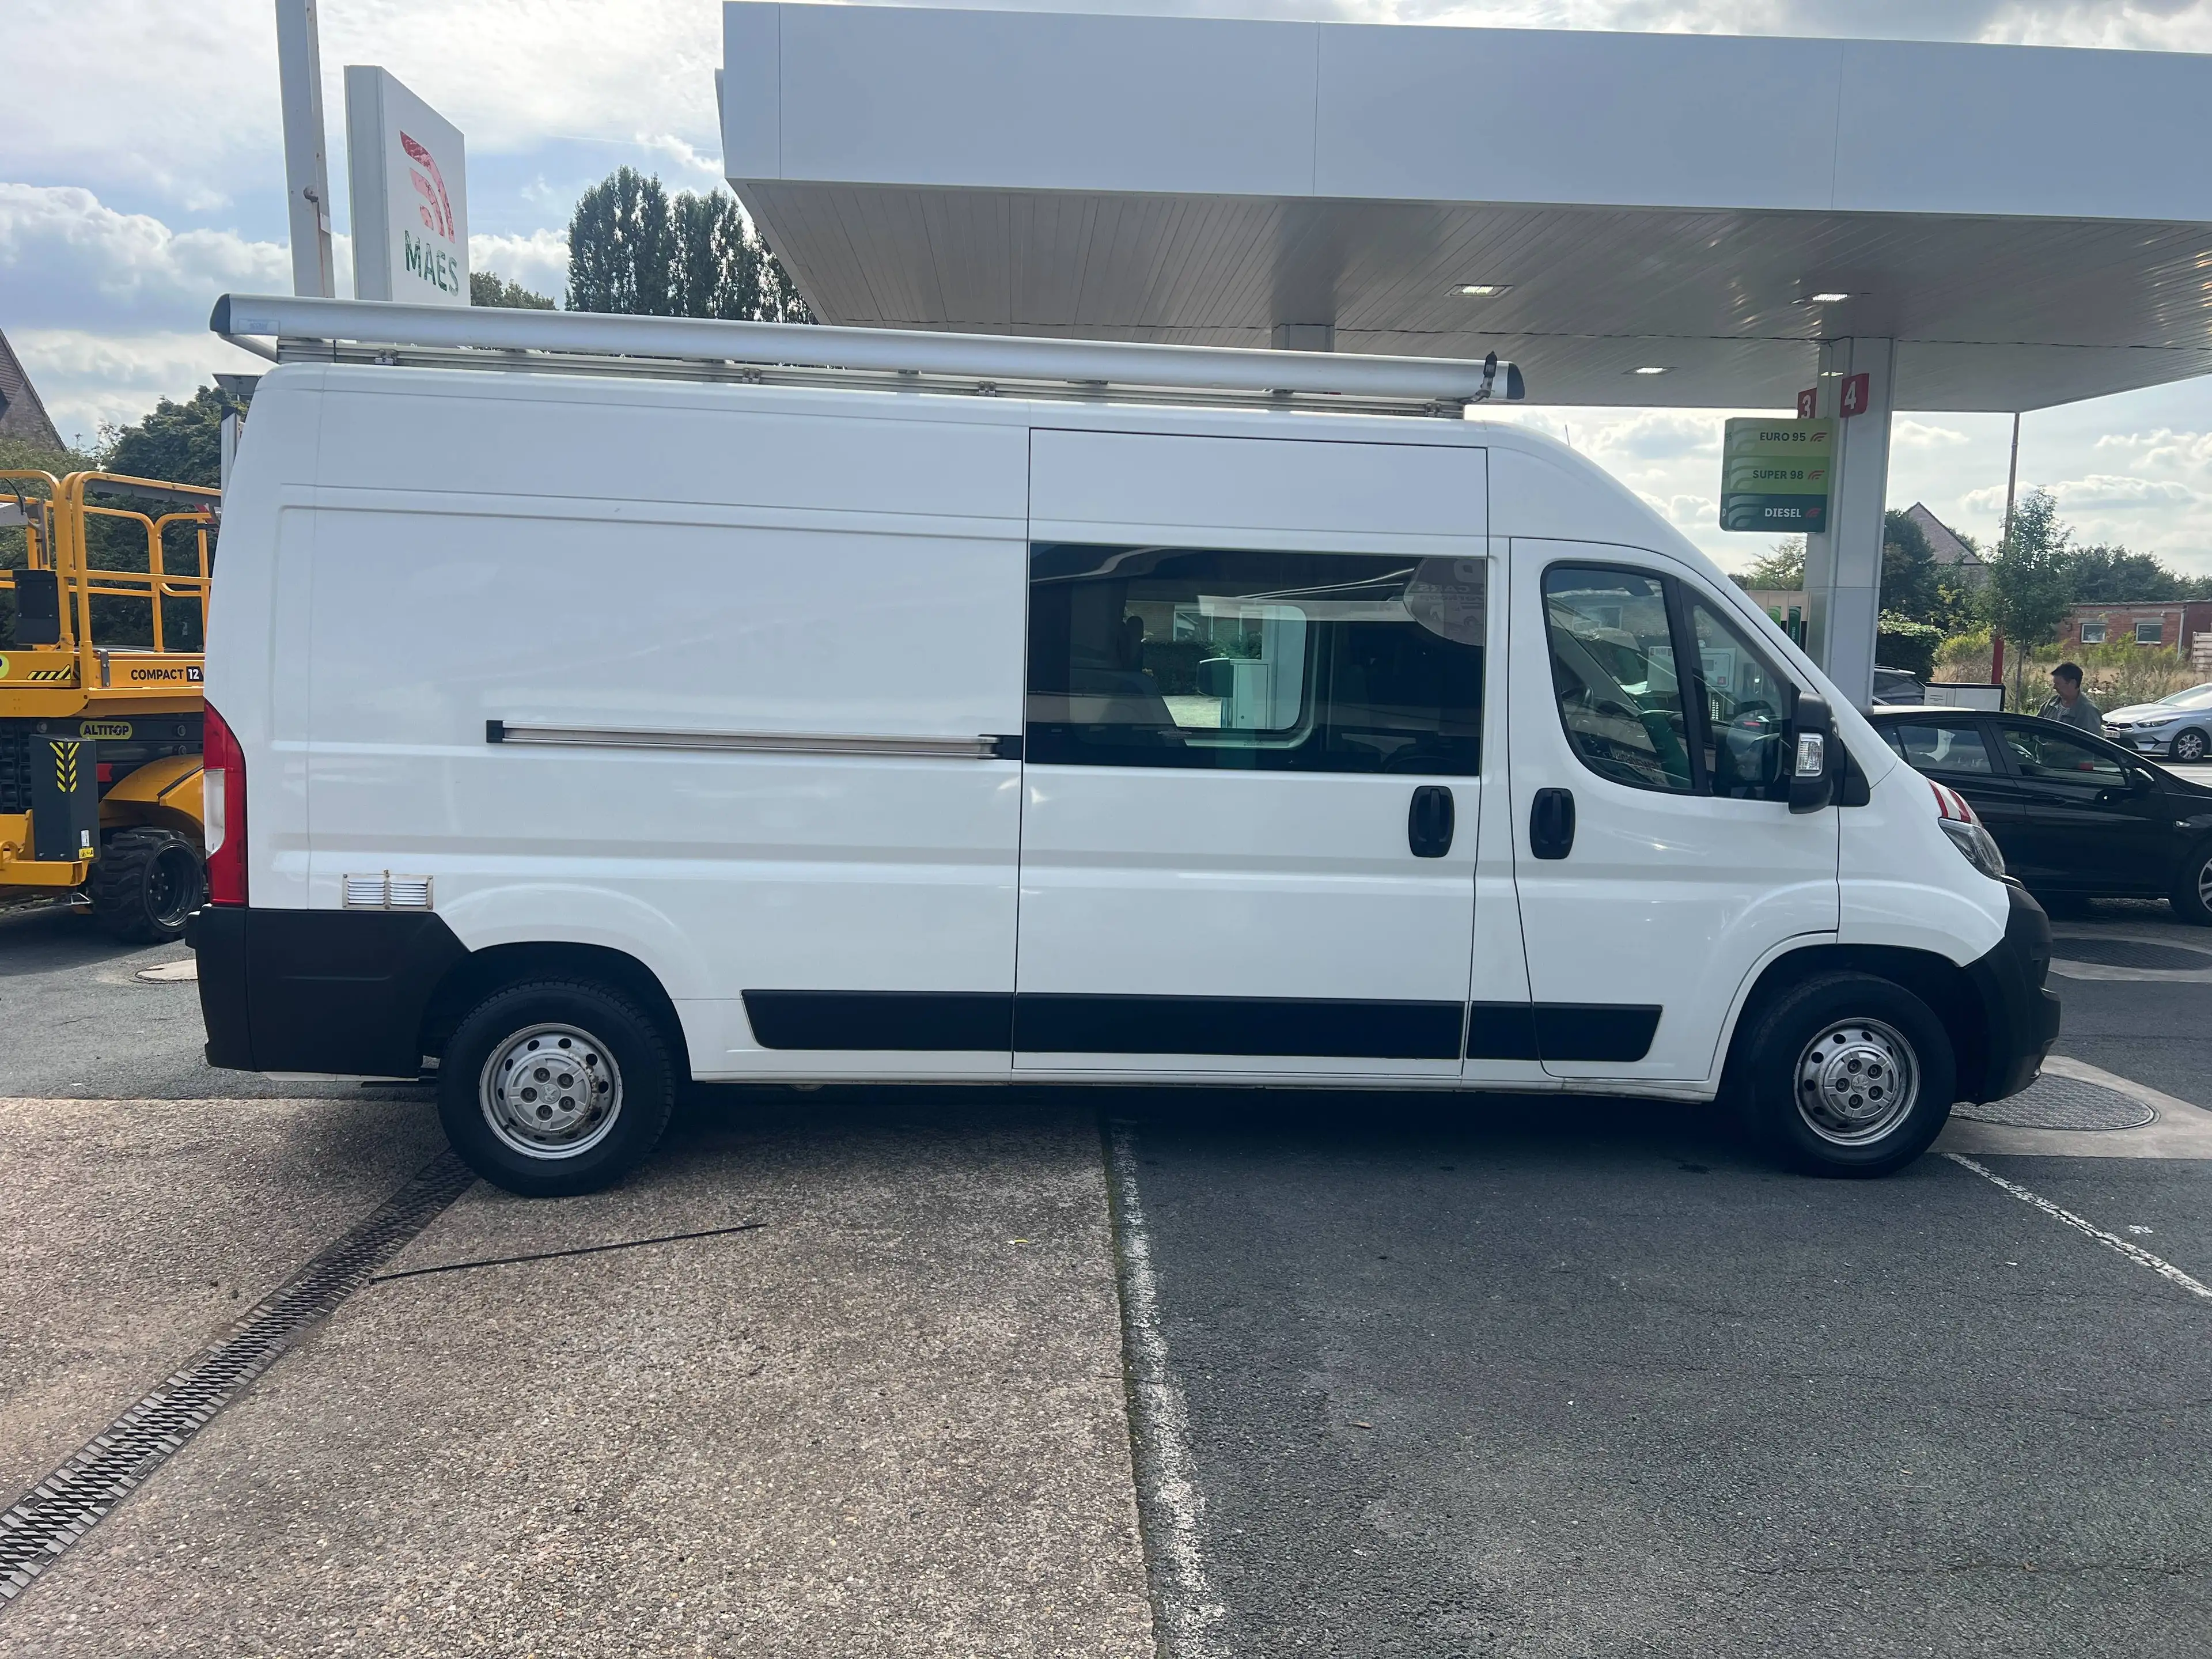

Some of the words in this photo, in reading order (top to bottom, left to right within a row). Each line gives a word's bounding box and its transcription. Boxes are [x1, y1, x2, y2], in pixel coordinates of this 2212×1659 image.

[405, 230, 459, 297] MAES
[1844, 381, 1857, 410] 4
[1801, 395, 1811, 418] 3
[1760, 432, 1790, 441] EURO
[1792, 432, 1806, 441] 95
[1753, 470, 1787, 479] SUPER
[1790, 470, 1804, 479] 98
[1764, 508, 1801, 517] DIESEL
[131, 669, 184, 680] COMPACT
[188, 669, 199, 680] 12
[83, 725, 129, 736] ALTITOP
